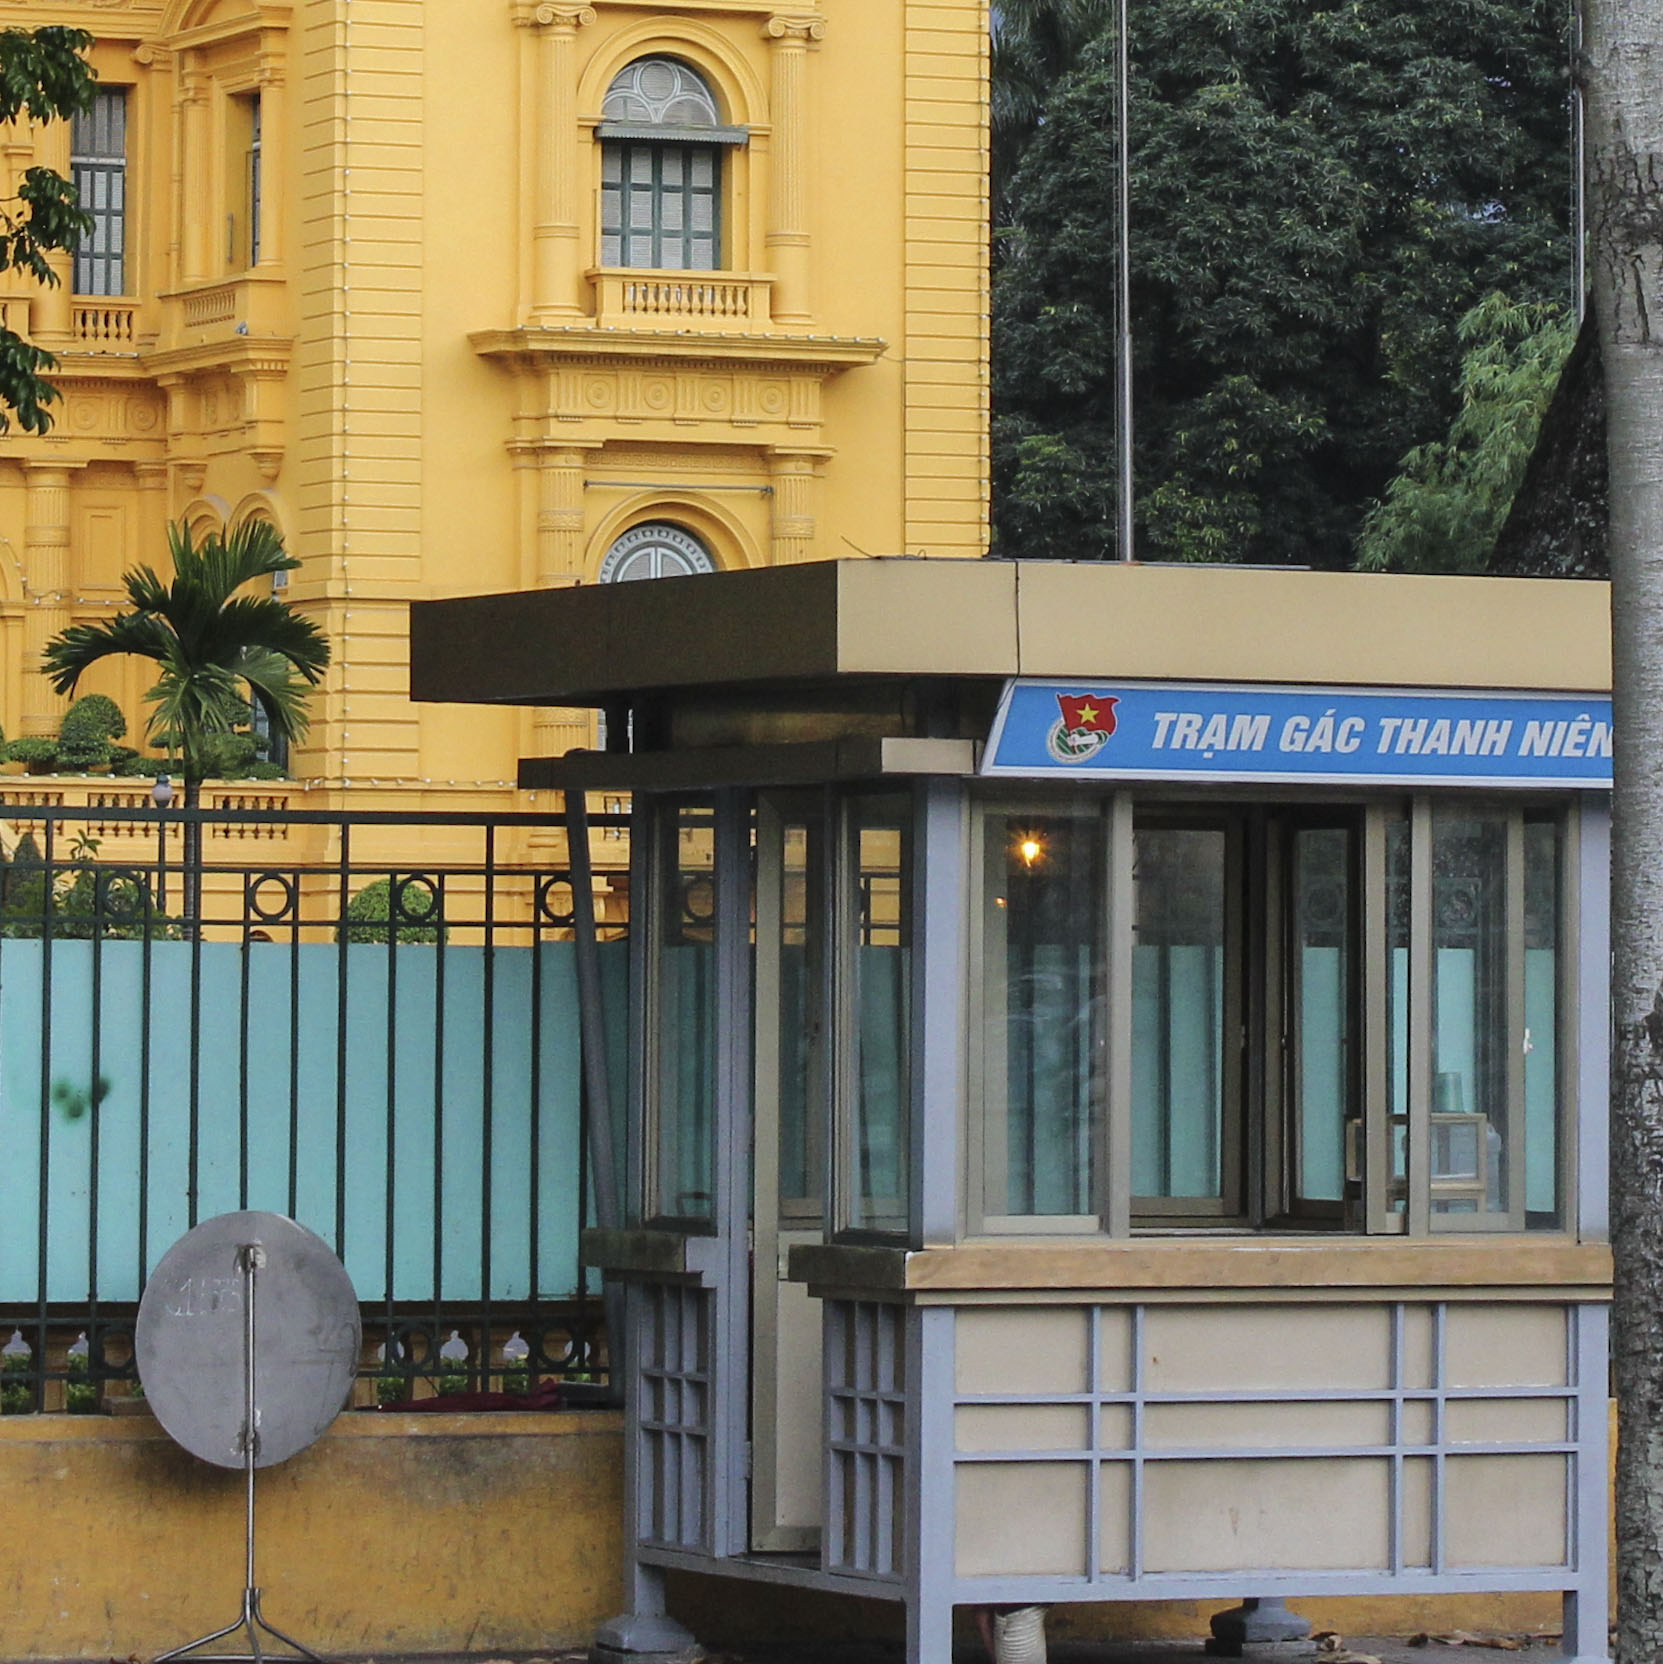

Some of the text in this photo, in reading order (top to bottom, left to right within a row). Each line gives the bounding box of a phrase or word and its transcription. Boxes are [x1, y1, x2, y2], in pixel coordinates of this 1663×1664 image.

[1151, 712, 1272, 759] TRẠM
[1278, 708, 1366, 754] GÁC
[1376, 717, 1514, 757] THANH
[1517, 713, 1614, 758] NIÊN
